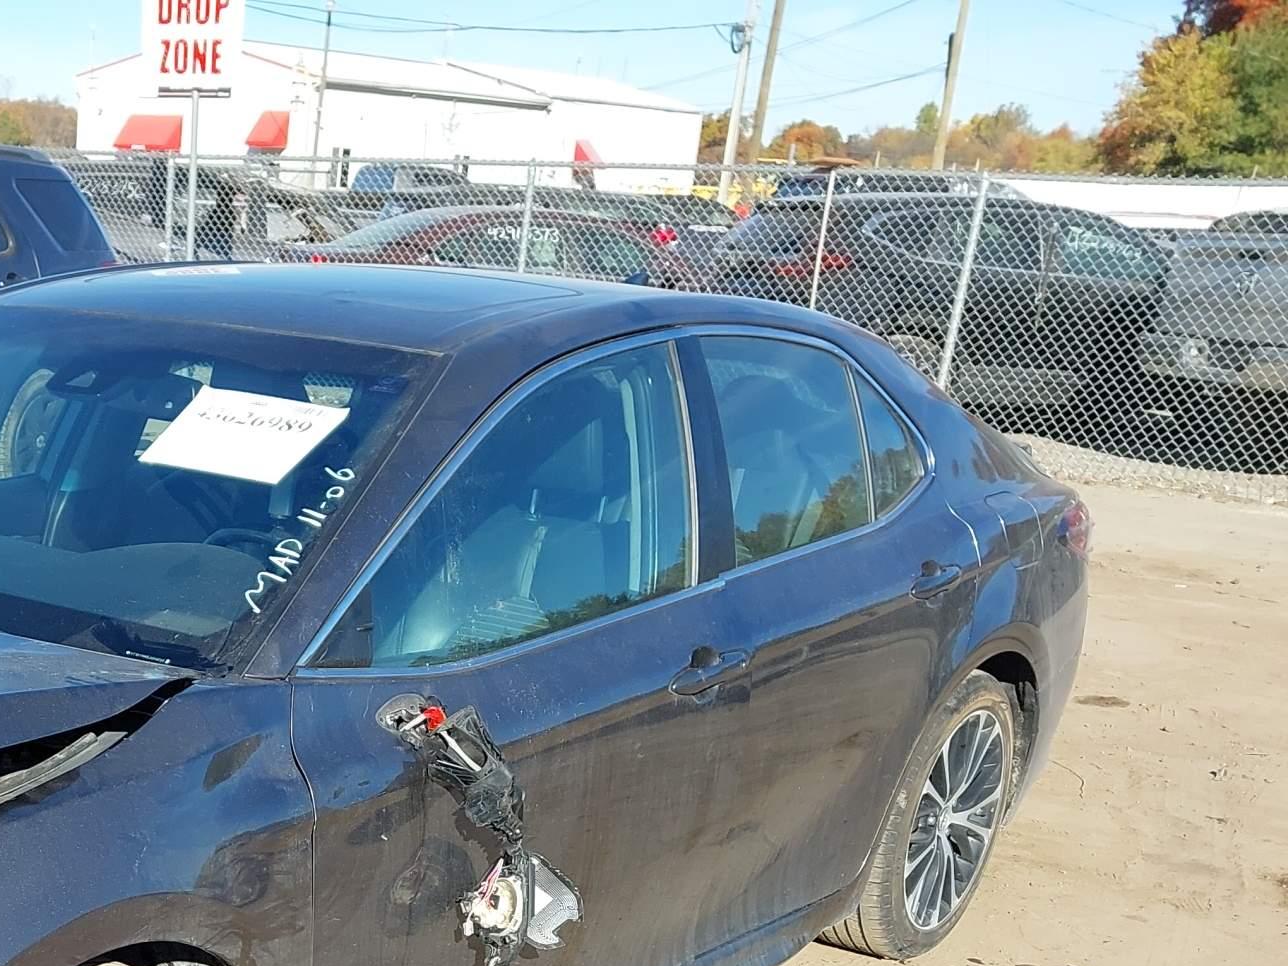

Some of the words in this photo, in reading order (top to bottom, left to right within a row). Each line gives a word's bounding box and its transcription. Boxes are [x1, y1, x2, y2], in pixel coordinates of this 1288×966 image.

[158, 0, 230, 25] DROP
[159, 39, 223, 75] ZONE
[245, 537, 304, 614] MAD
[297, 466, 356, 528] 11-06
